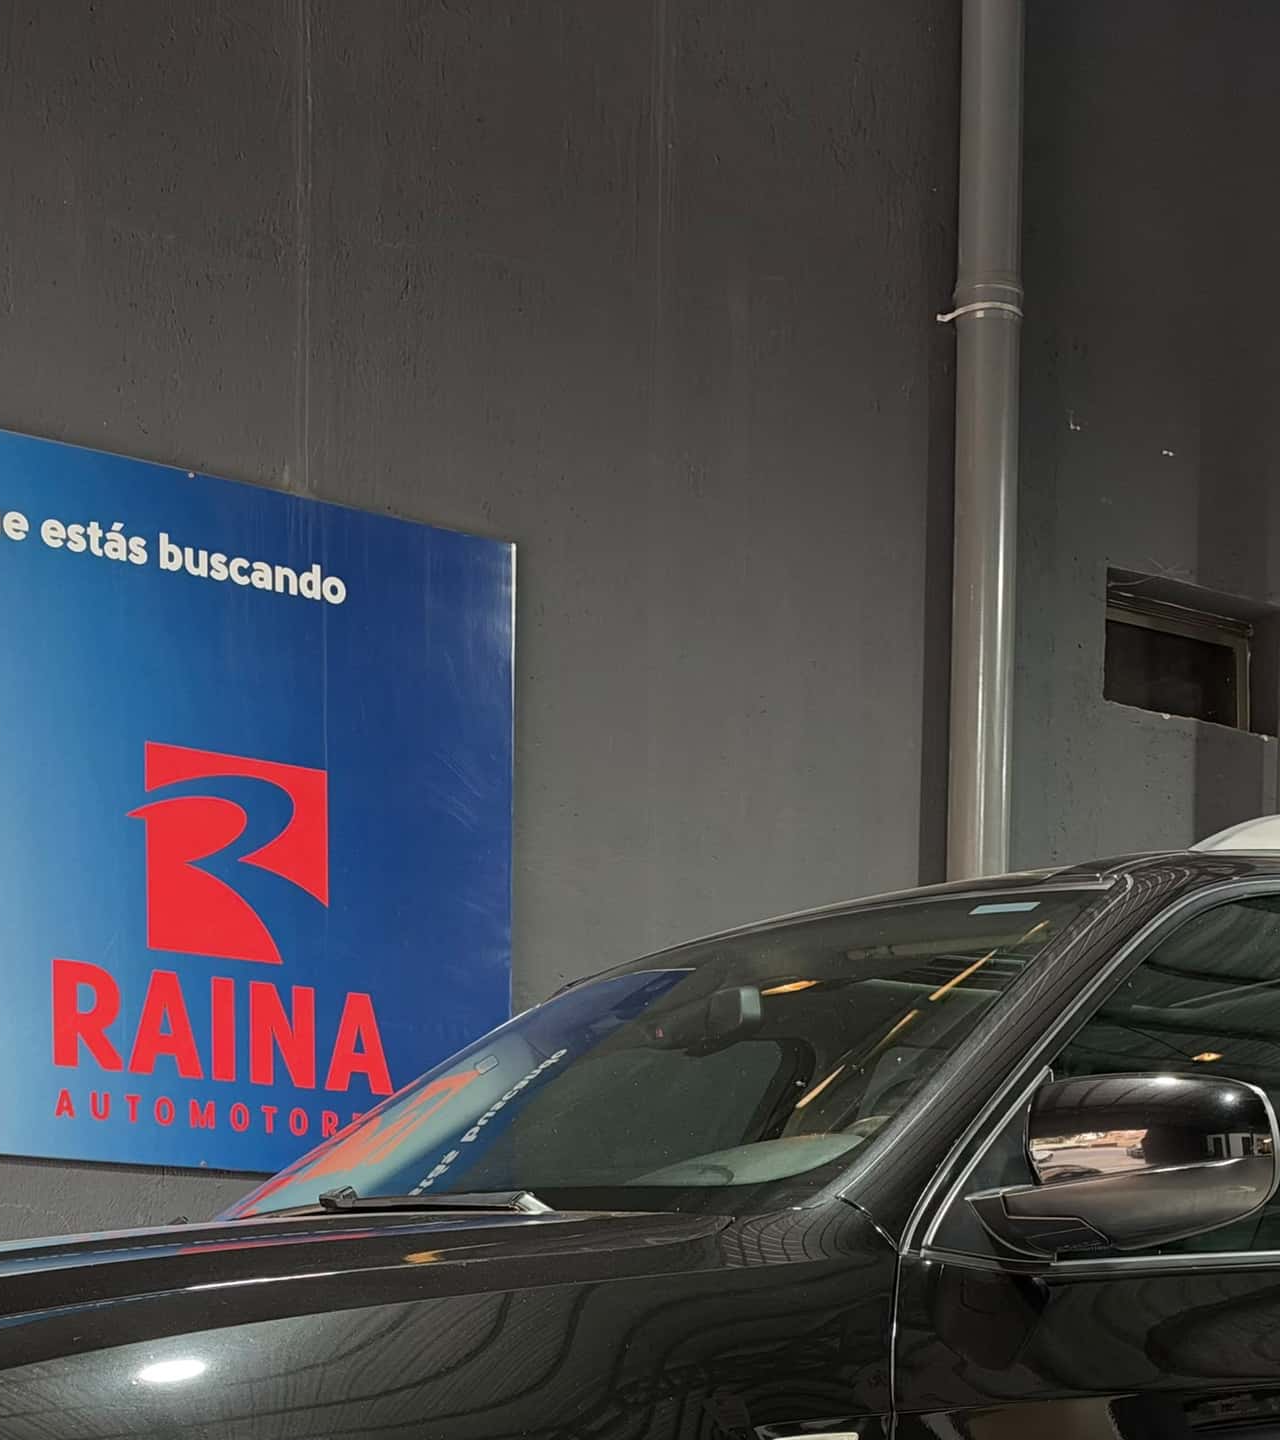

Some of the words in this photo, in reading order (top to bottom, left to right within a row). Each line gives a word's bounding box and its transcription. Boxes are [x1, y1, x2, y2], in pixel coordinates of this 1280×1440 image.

[40, 518, 149, 566] estás
[159, 533, 347, 606] buscando
[51, 958, 394, 1096] RAINA
[55, 1088, 364, 1138] AUTOMOTOR
